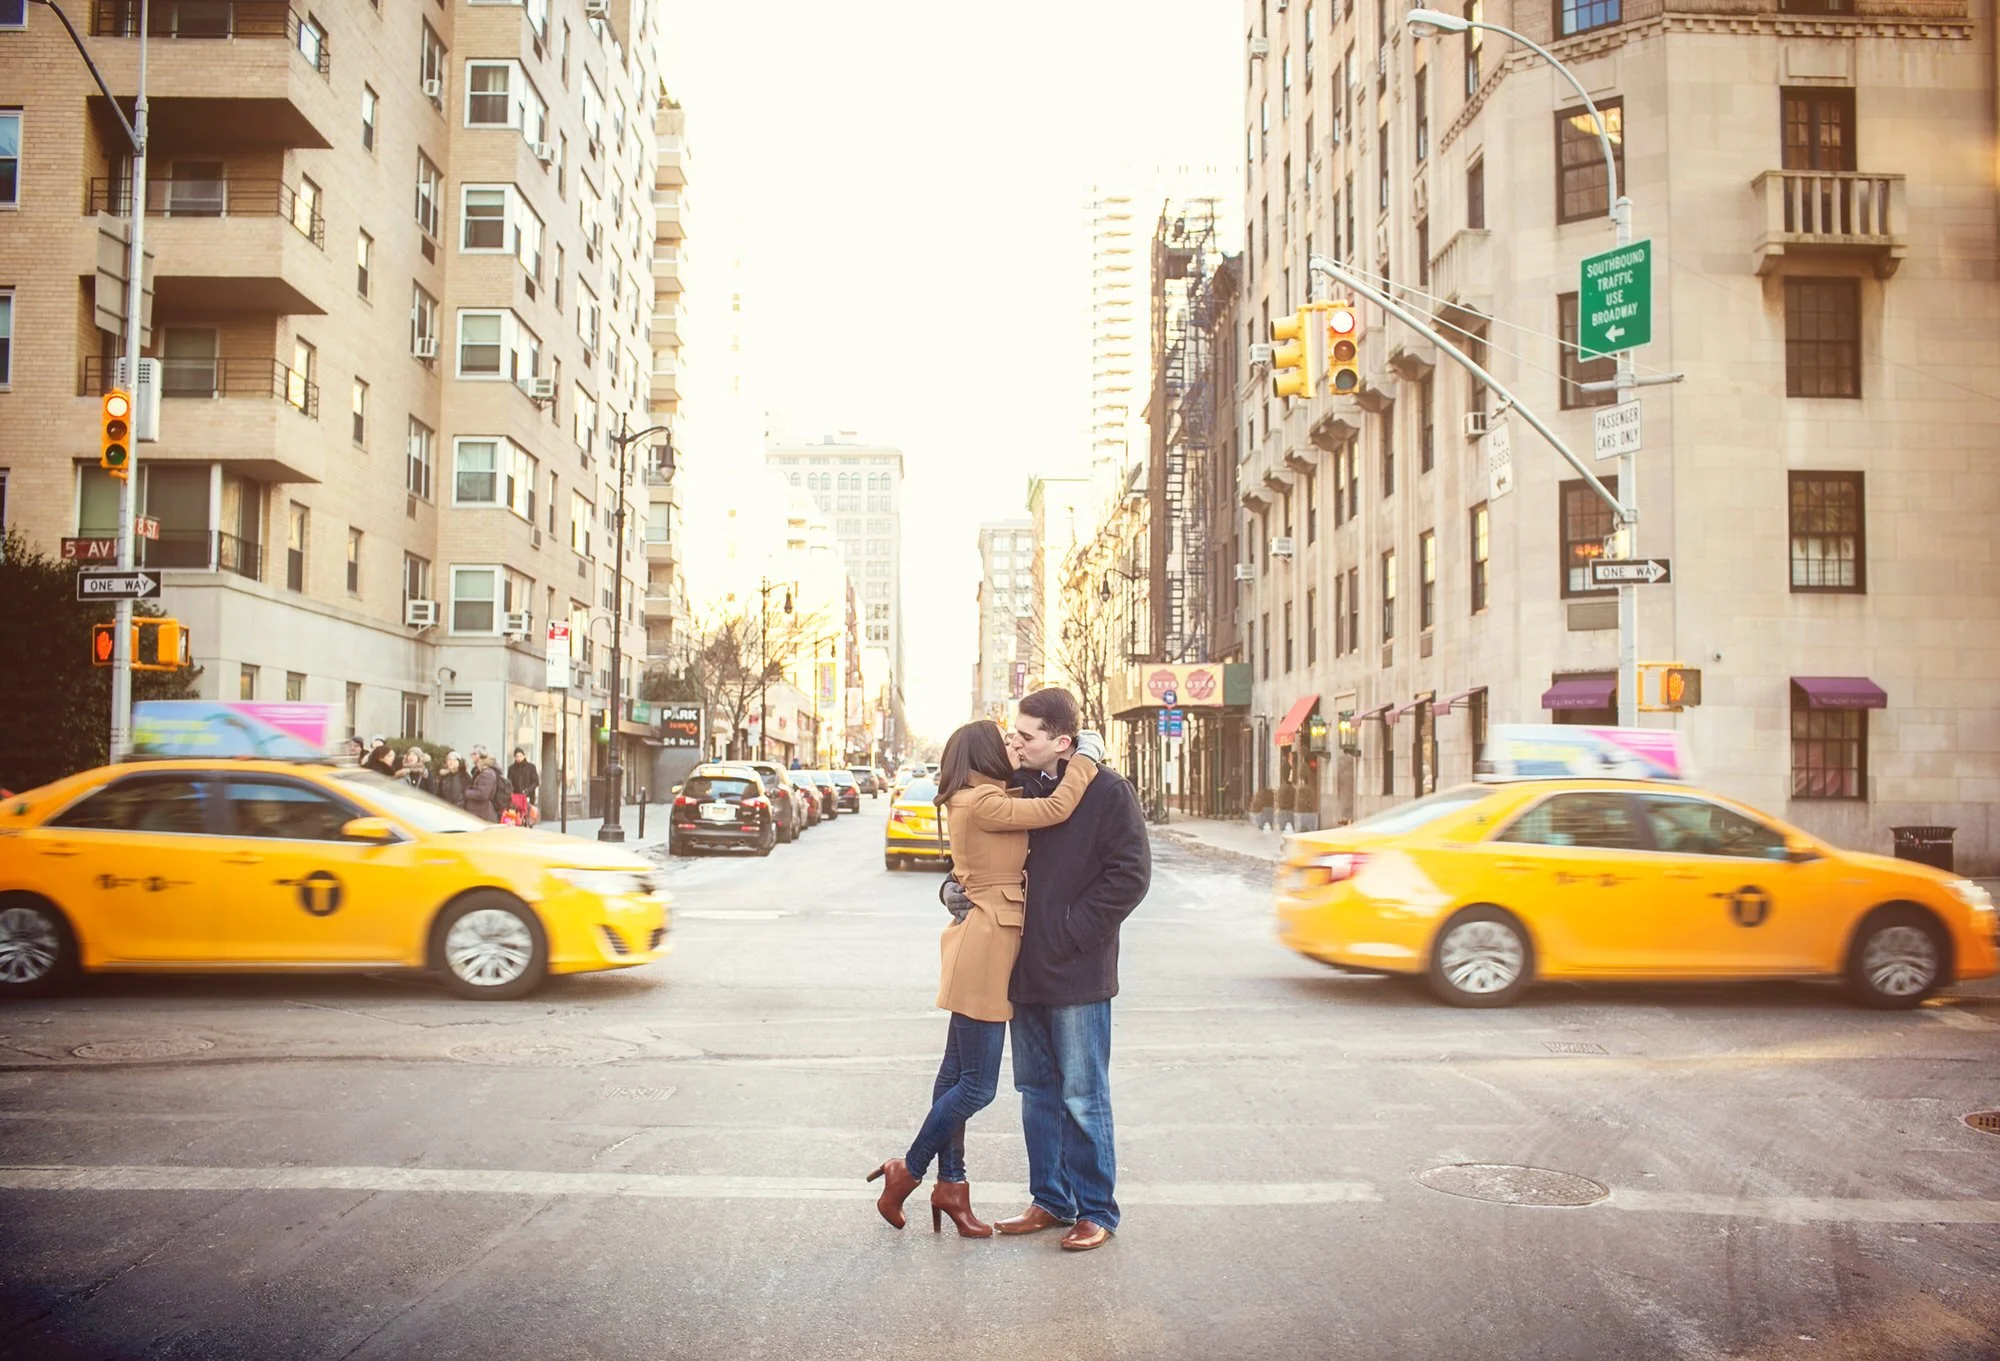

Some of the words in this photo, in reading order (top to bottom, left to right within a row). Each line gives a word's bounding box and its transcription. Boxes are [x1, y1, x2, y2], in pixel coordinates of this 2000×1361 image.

[1586, 249, 1645, 278] SOUTHBOUND
[1597, 270, 1634, 292] TRAFFIC
[1605, 289, 1624, 306] USE
[1591, 302, 1639, 327] BROADWAY
[1597, 407, 1639, 431] PASSENGER
[1492, 431, 1506, 447] ALL
[1597, 433, 1616, 451] CARS
[1620, 427, 1639, 445] ONLY
[1489, 447, 1510, 473] BUSES
[146, 519, 158, 540] ST
[65, 541, 76, 557] 5
[87, 541, 110, 557] AV
[1602, 567, 1625, 577] ONE
[1635, 567, 1659, 577] WAY
[90, 580, 113, 591] ONE
[124, 579, 149, 591] WAY
[1148, 680, 1178, 688] OTTO
[663, 709, 698, 720] PARK
[663, 737, 676, 746] 24
